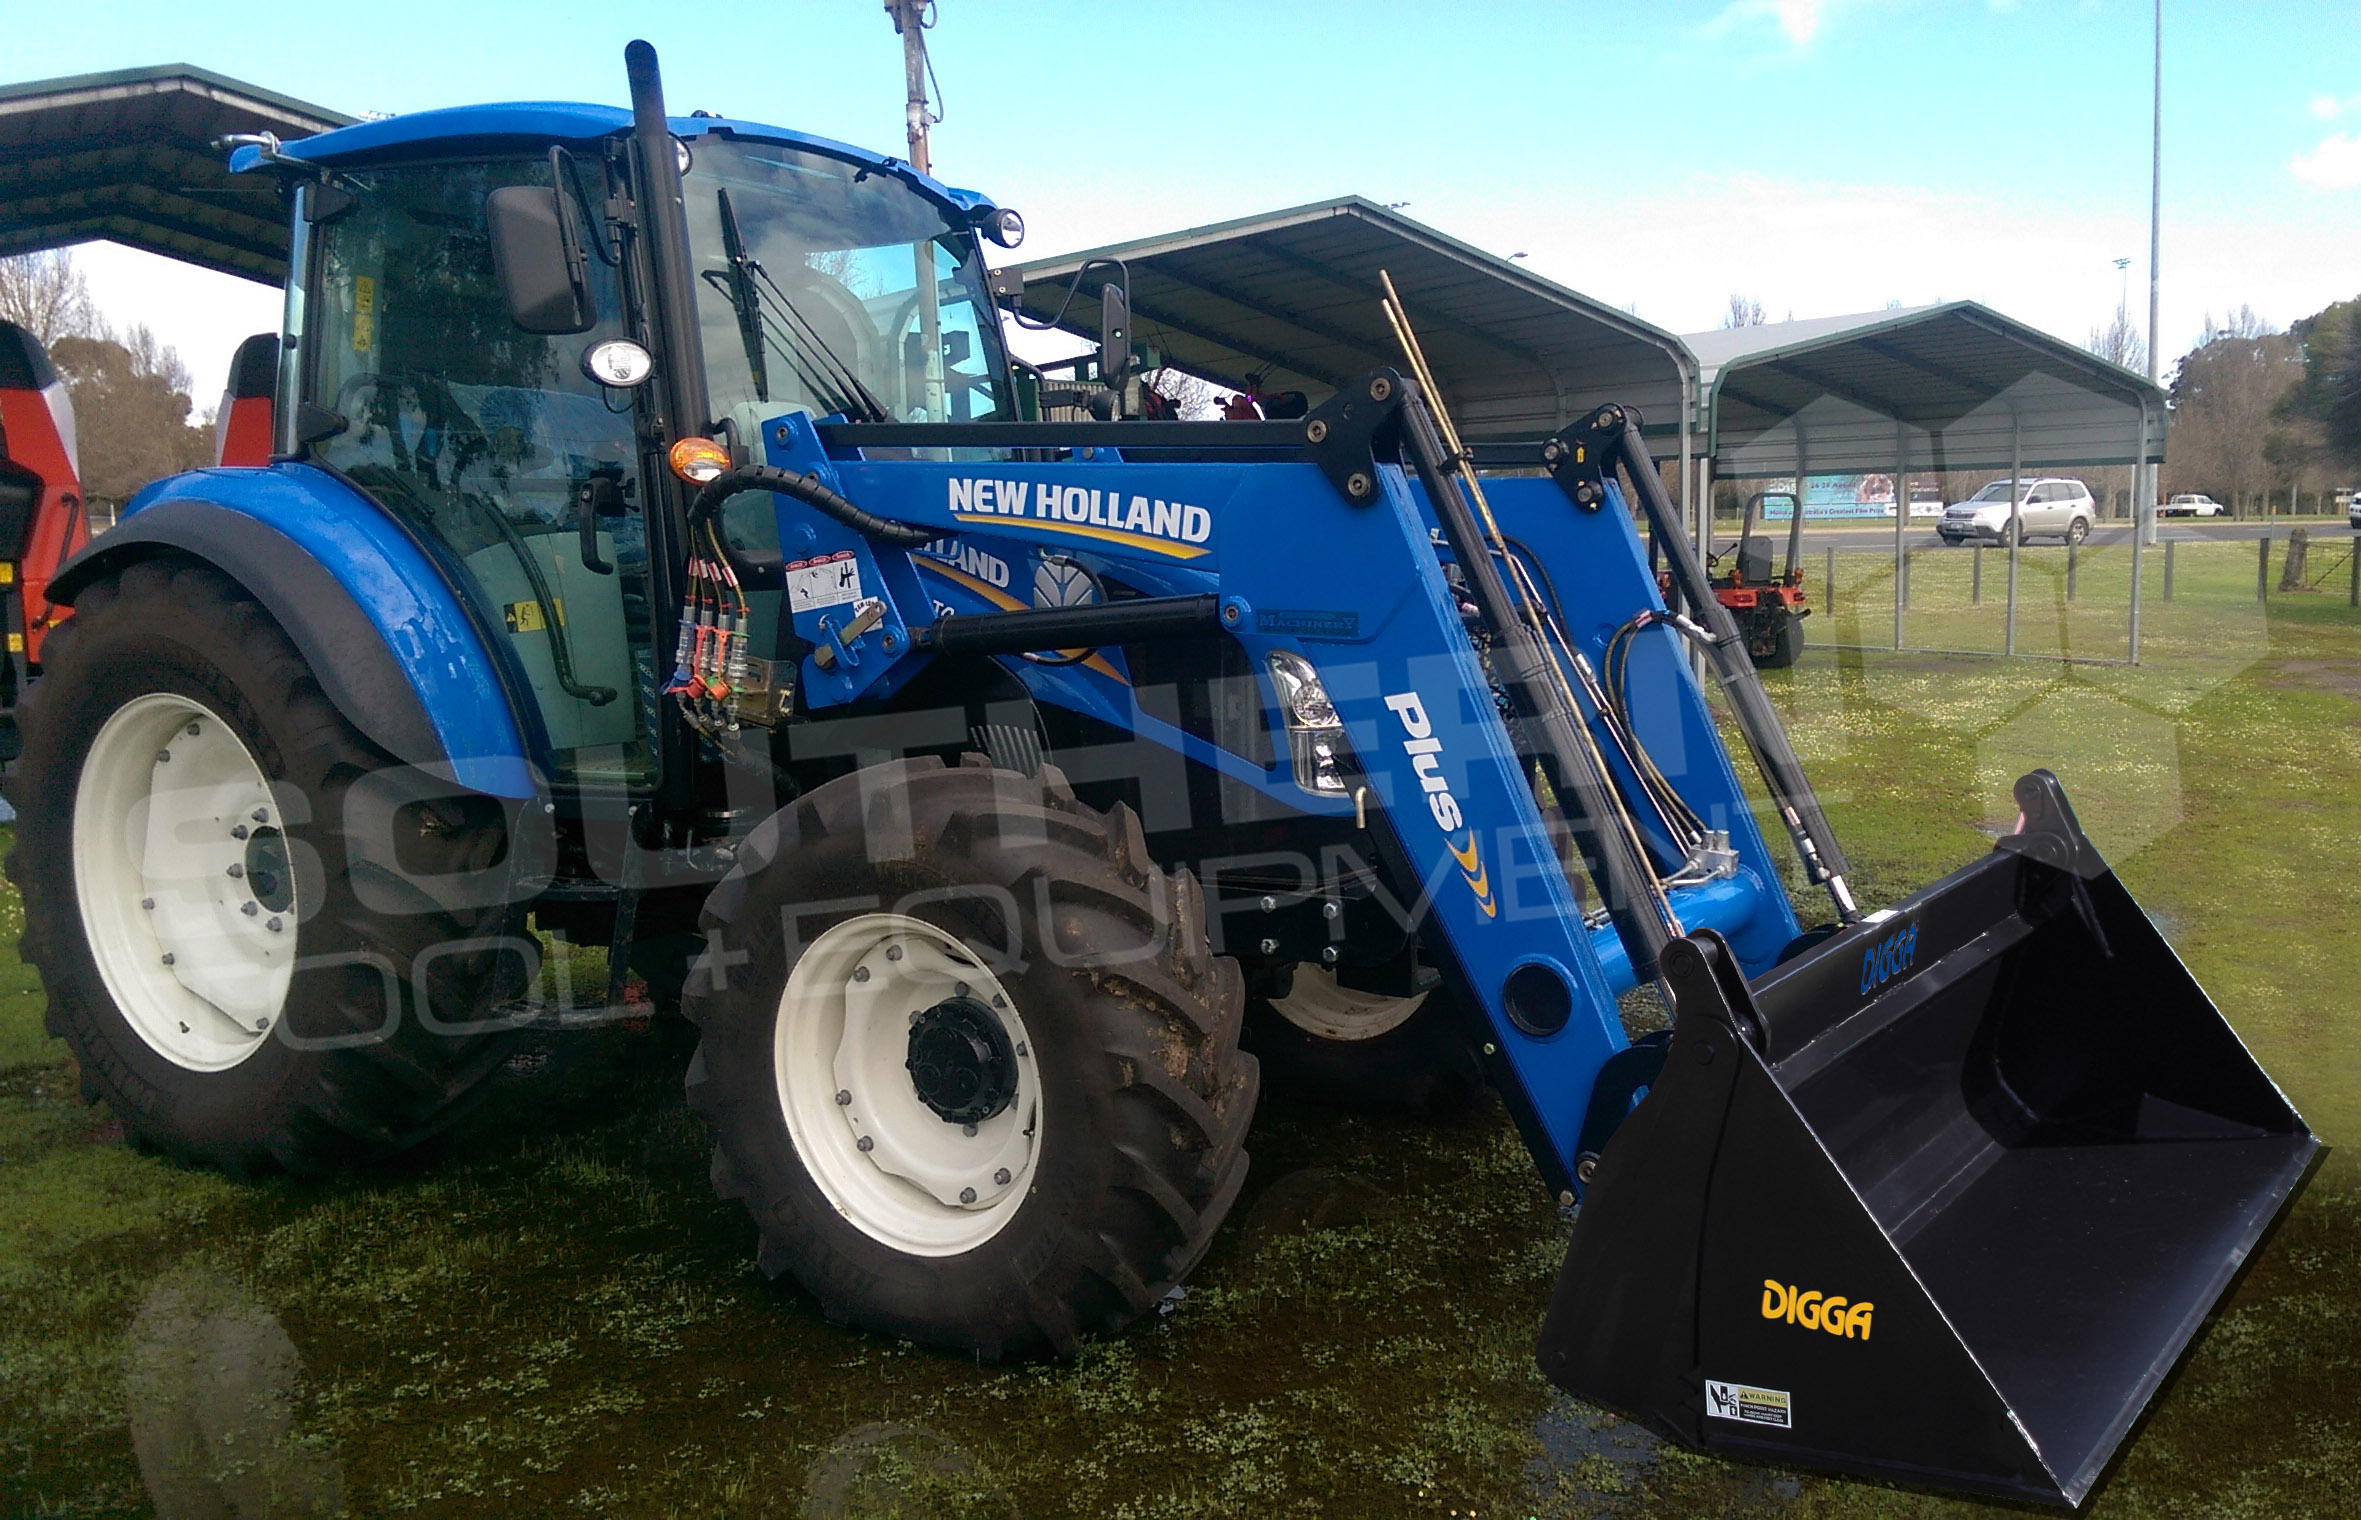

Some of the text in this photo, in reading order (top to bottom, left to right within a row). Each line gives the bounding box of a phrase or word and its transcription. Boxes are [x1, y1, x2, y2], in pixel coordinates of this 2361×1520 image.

[949, 478, 1211, 543] NEW HOLLAND
[1384, 692, 1462, 832] Plus
[1861, 922, 1919, 995] DIGGA
[1761, 1279, 1874, 1340] DIGGA
[1749, 1391, 1787, 1404] WARNING
